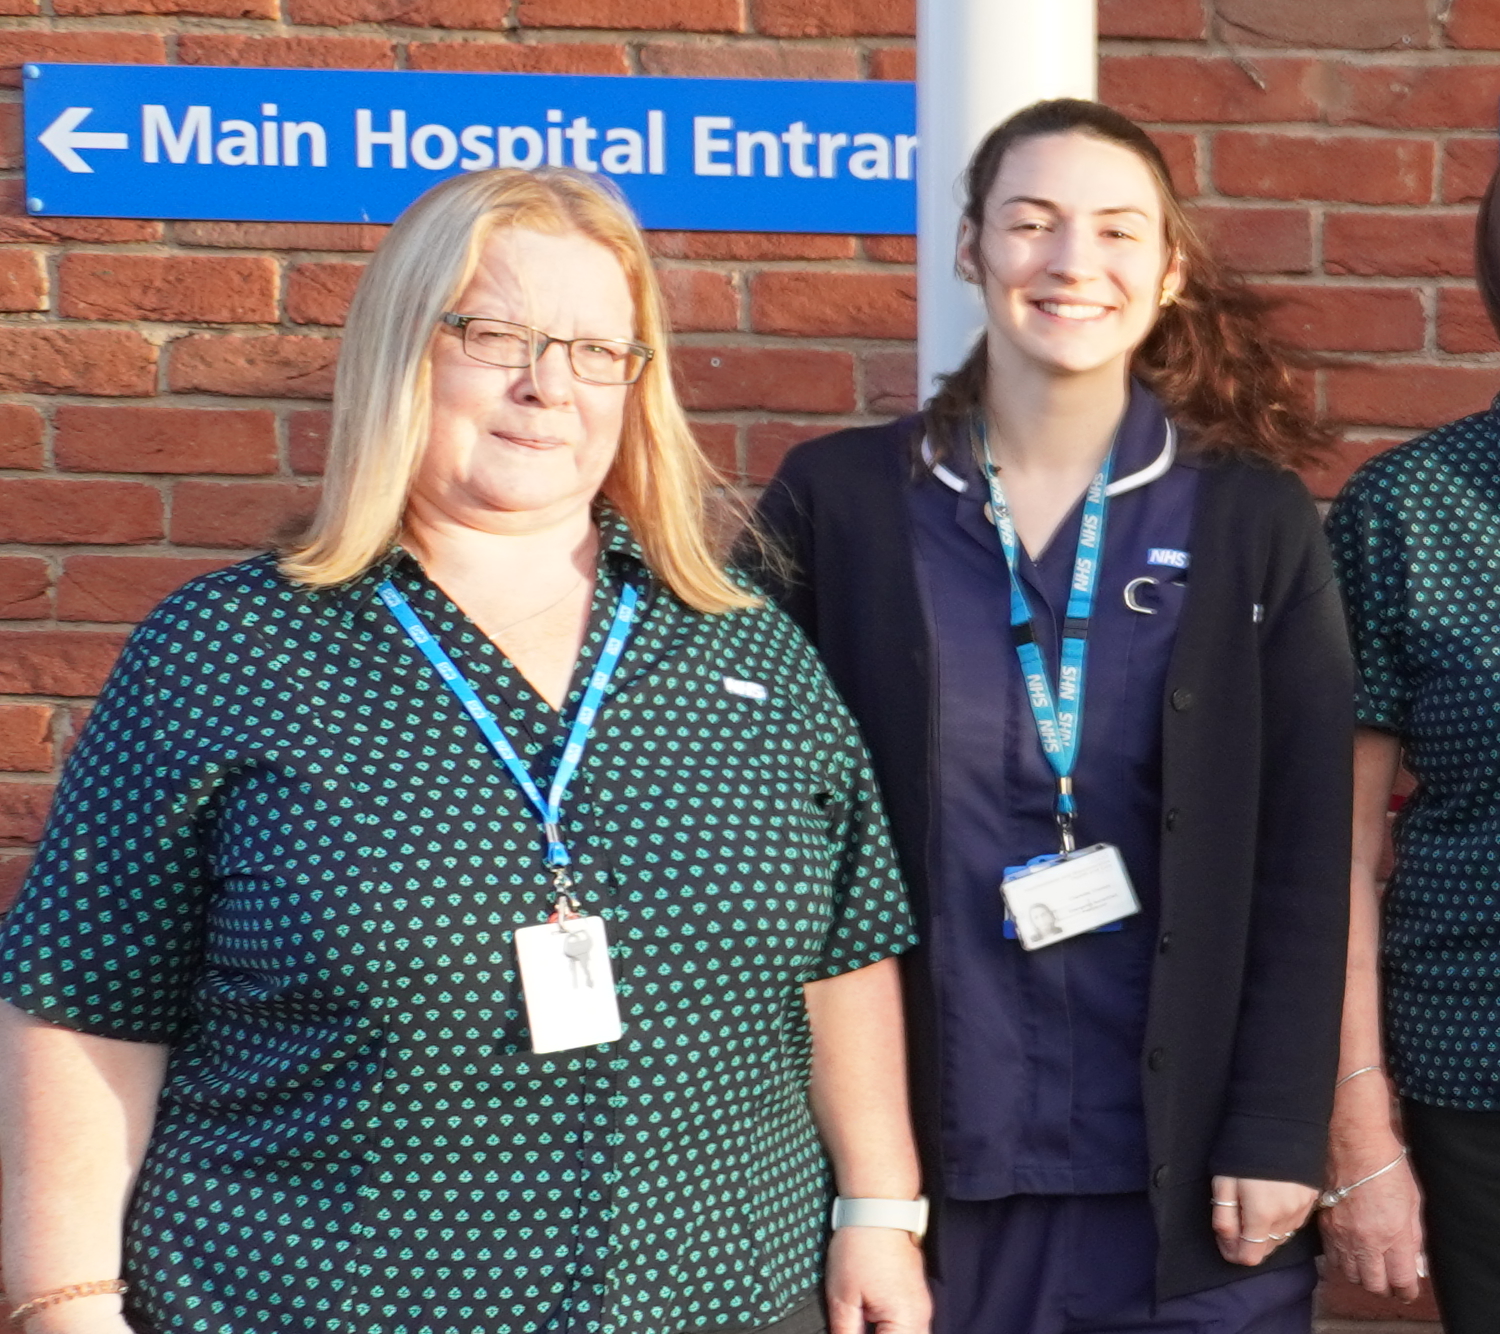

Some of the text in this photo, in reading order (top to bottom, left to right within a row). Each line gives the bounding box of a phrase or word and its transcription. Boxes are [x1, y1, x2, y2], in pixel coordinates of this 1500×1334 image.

[141, 103, 918, 179] Main Hospital Entra
[1088, 472, 1104, 504] NHS
[998, 517, 1013, 547] NHS
[1081, 514, 1098, 549] NHS
[1073, 557, 1092, 591] NHS
[1149, 549, 1186, 566] NHS
[1027, 674, 1048, 707] NHS
[1060, 666, 1076, 700] NHS
[1038, 720, 1059, 753] NHS
